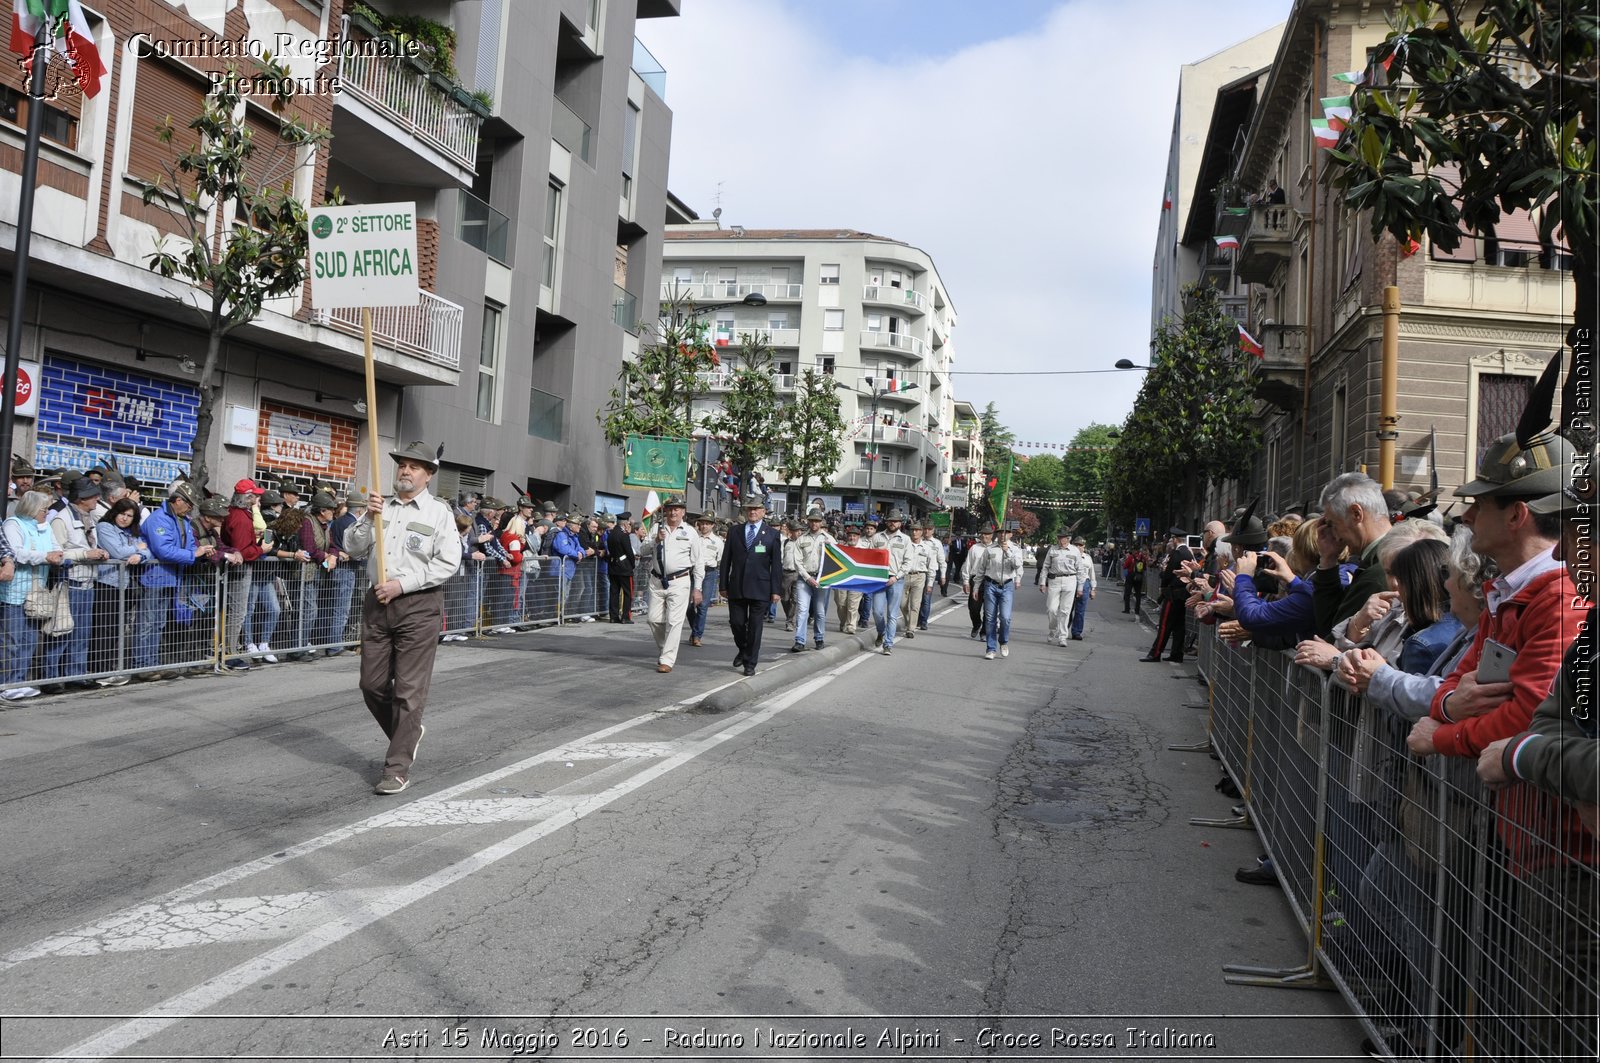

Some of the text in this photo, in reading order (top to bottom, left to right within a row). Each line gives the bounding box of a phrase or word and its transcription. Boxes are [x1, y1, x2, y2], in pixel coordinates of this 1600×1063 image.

[352, 213, 412, 233] SETTORE
[314, 248, 413, 279] SUD AFRICA
[117, 396, 155, 424] TIM
[275, 439, 324, 462] WIND
